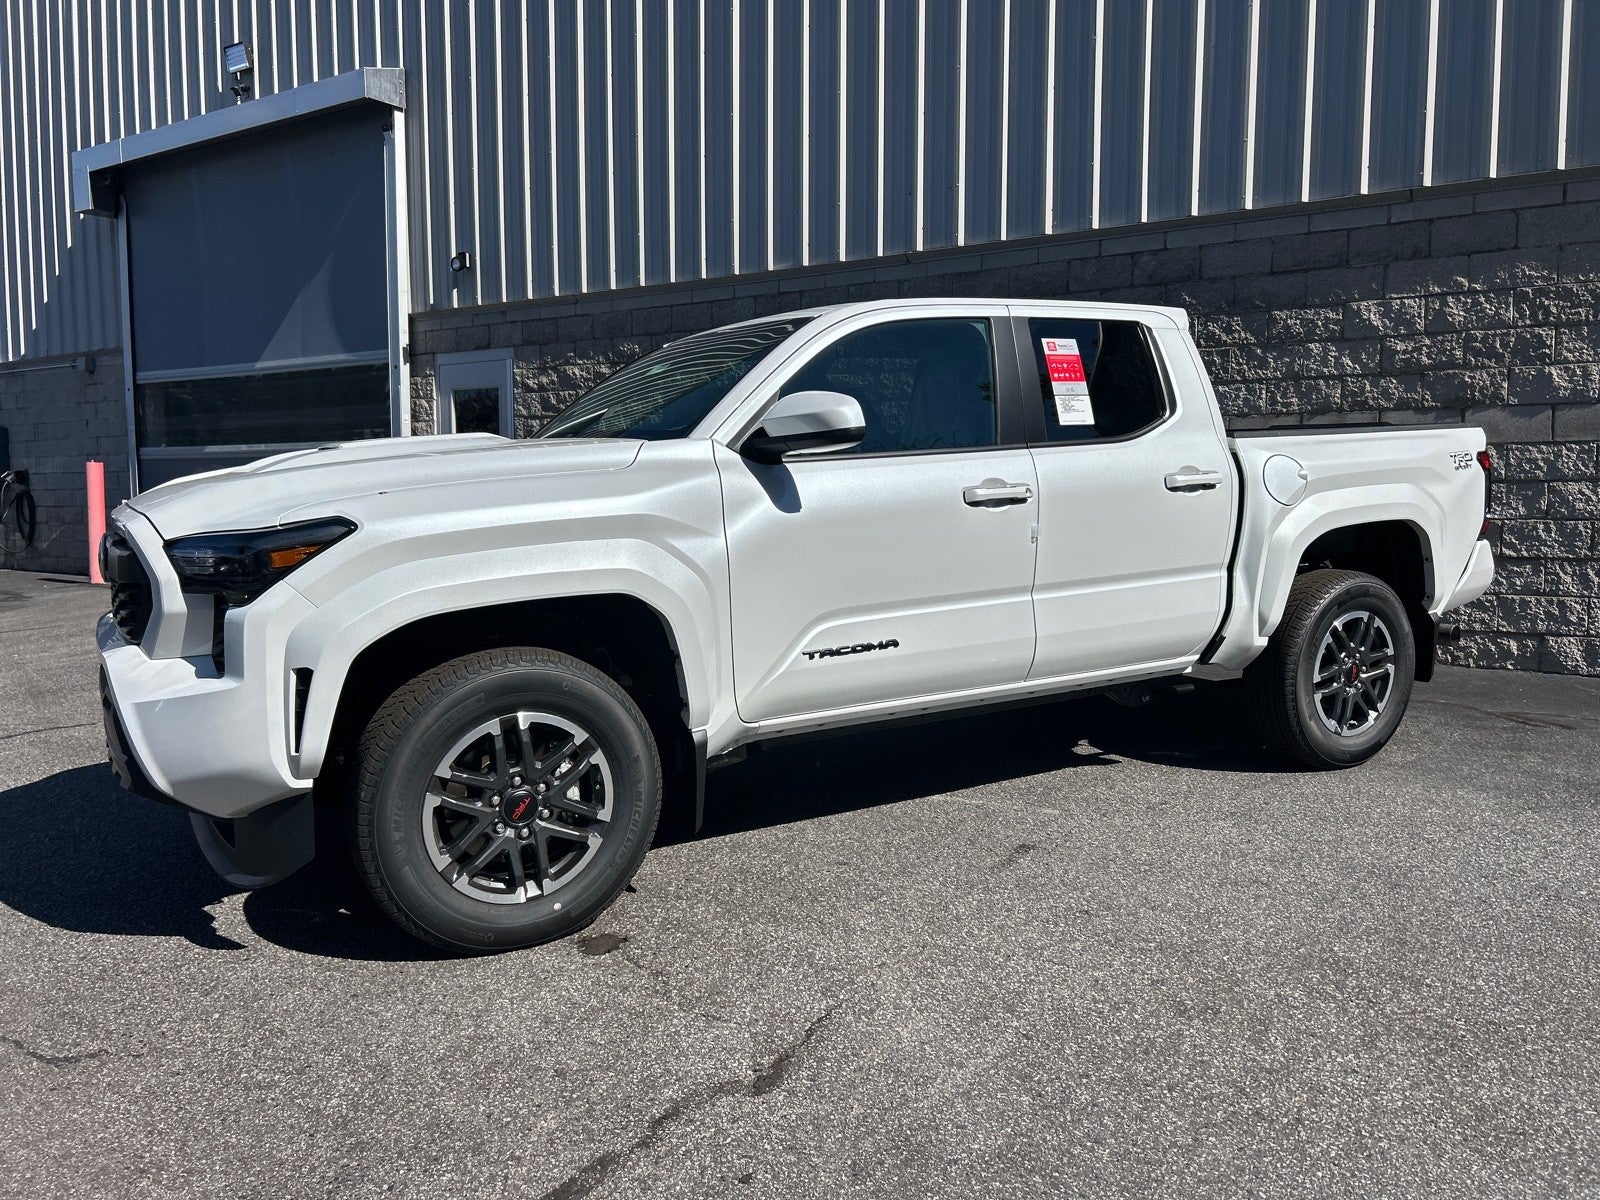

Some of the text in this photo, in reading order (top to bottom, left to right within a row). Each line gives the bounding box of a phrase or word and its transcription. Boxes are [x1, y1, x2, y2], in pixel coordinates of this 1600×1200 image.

[1449, 451, 1473, 466] TRD
[802, 638, 900, 660] TACOMA
[512, 796, 531, 820] TRD
